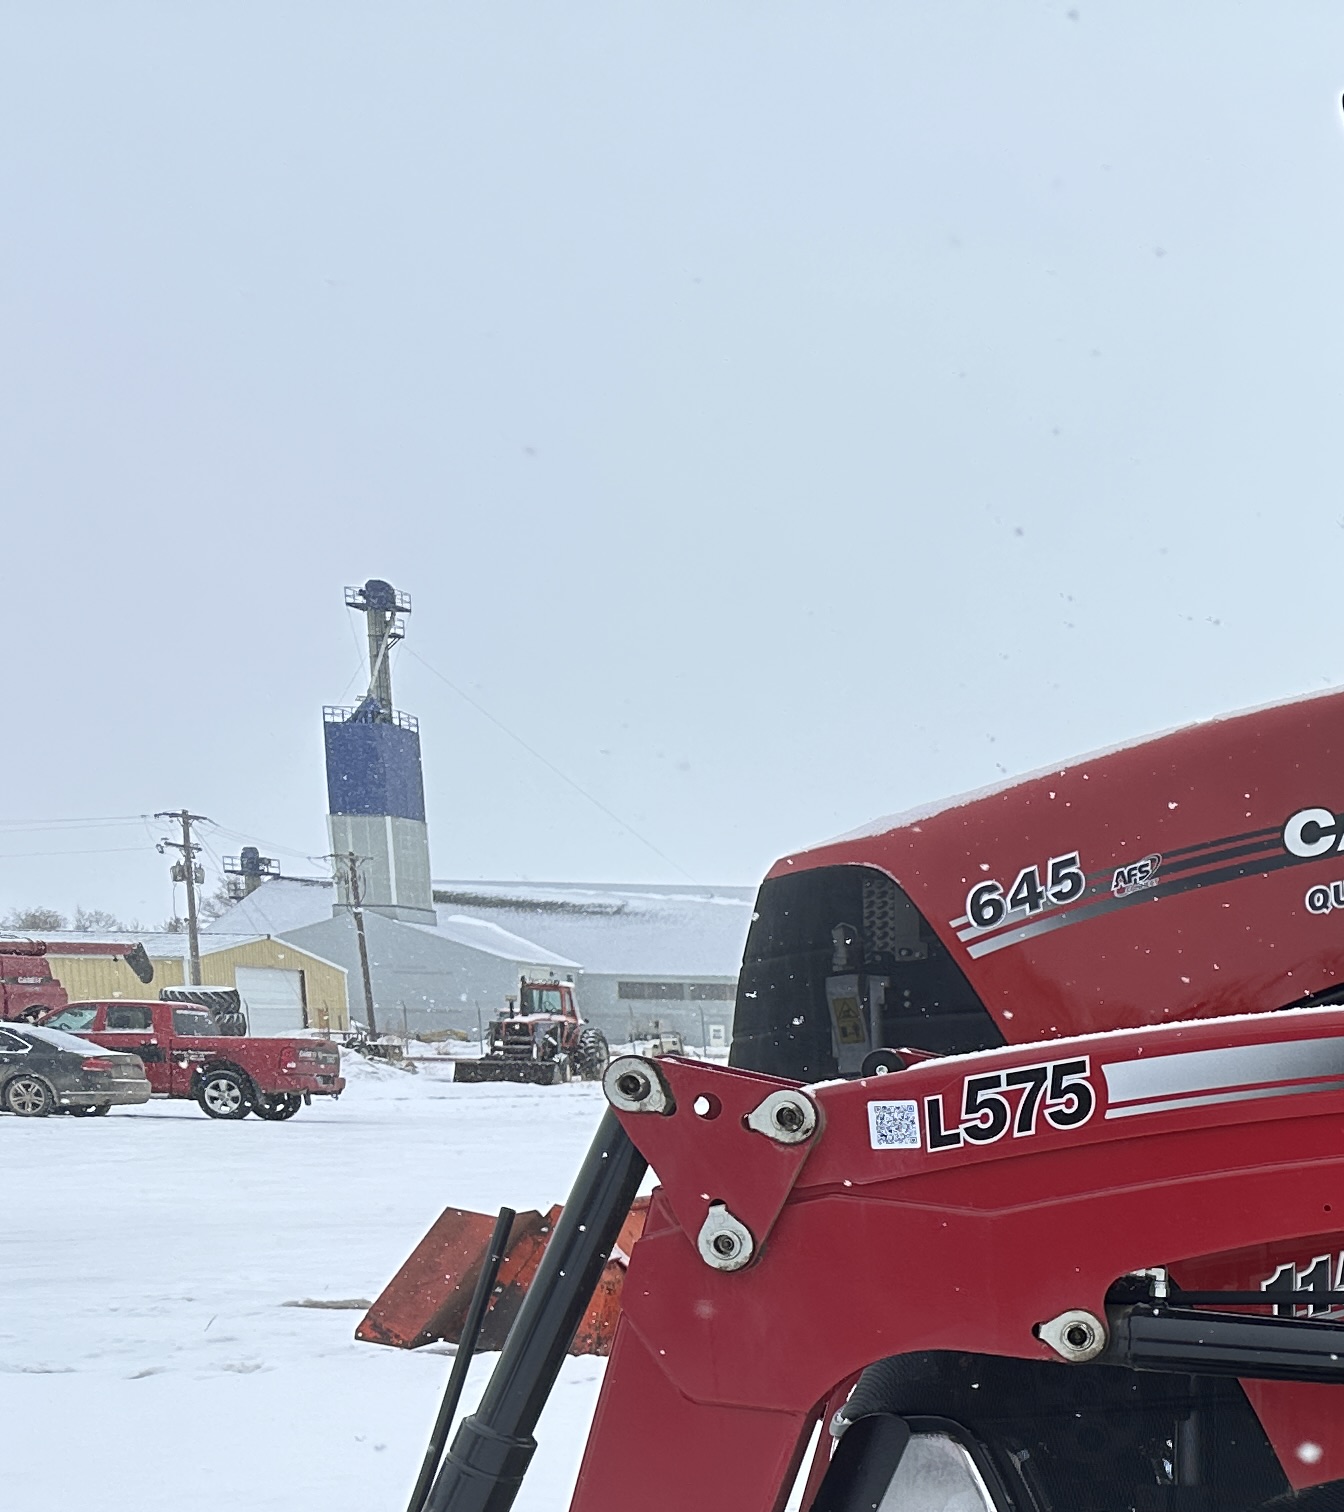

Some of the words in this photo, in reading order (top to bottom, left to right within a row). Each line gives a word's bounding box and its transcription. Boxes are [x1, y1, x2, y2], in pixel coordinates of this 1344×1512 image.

[965, 850, 1086, 930] 645
[1111, 859, 1152, 892] AFS
[924, 1055, 1096, 1153] L575
